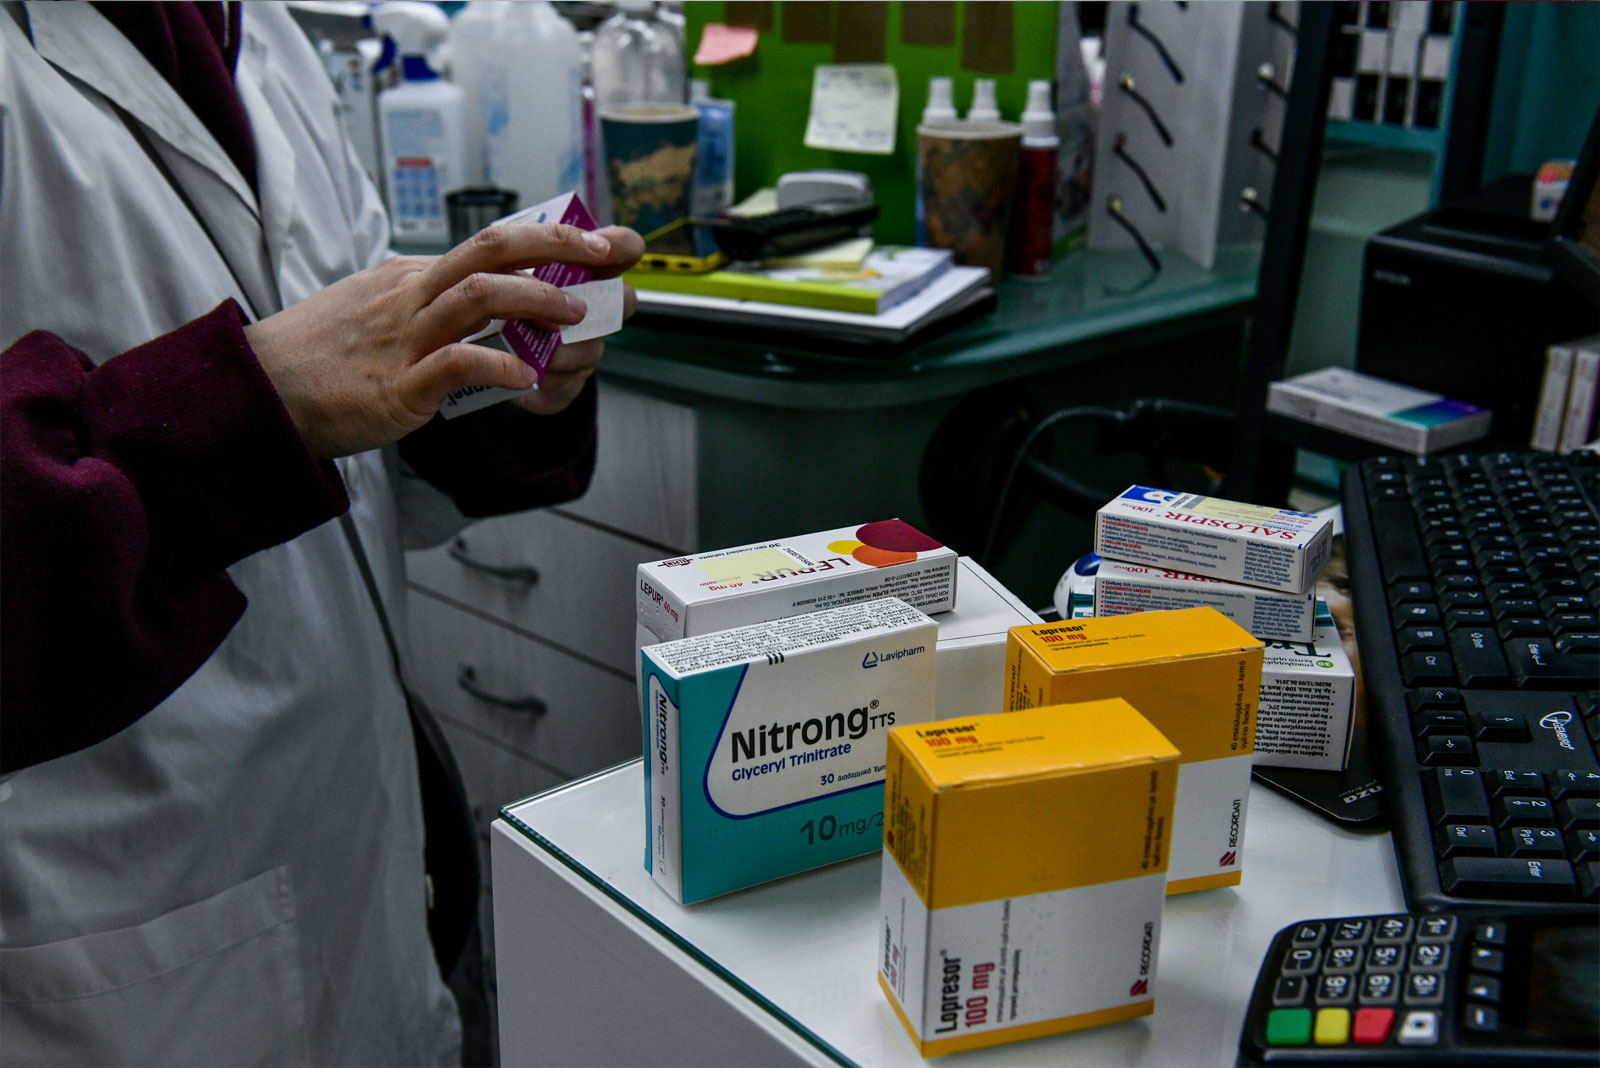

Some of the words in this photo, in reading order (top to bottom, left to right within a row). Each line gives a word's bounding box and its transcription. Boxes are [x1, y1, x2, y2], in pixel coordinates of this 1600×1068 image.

[1040, 634, 1061, 643] 100
[1066, 632, 1087, 642] mg
[880, 645, 925, 662] Lavipharm
[870, 711, 896, 730] TTS
[925, 736, 951, 748] 100
[956, 734, 978, 746] mg
[732, 757, 785, 782] Glyceryl
[790, 742, 851, 767] Trinitrate
[820, 773, 835, 786] 30
[1530, 800, 1547, 808] 2
[1229, 799, 1241, 848] RECORDATI
[801, 814, 837, 845] 10
[1540, 830, 1557, 838] 3
[1528, 860, 1543, 877] Enter
[1343, 920, 1362, 929] 7
[1383, 919, 1404, 928] 4
[1292, 949, 1312, 959] 0
[1333, 948, 1353, 958] 8
[1374, 947, 1397, 957] 5
[1417, 945, 1440, 956] 2
[973, 962, 996, 991] mg
[1325, 976, 1347, 987] 9
[1368, 975, 1390, 986] 6
[1412, 974, 1437, 986] 3
[966, 996, 988, 1028] 100
